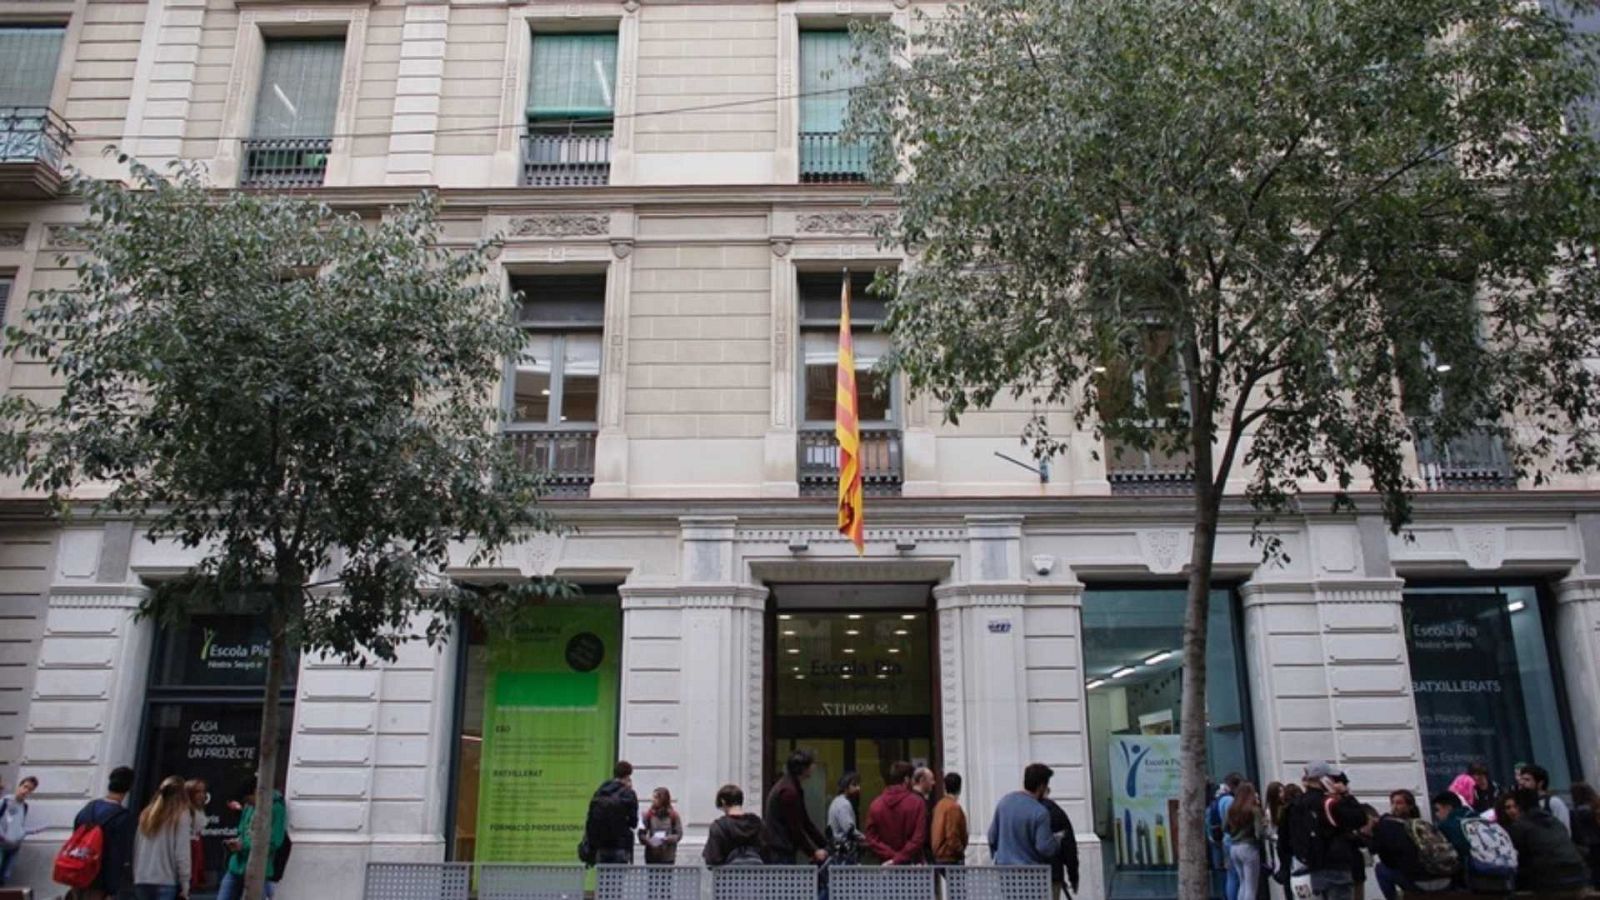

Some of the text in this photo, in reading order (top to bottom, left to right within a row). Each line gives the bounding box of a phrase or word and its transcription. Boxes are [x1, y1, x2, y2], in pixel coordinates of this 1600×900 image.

[1413, 622, 1478, 638] Escola Pia
[210, 644, 248, 657] Escola
[191, 720, 219, 732] CADA
[187, 747, 256, 759] UN PROJECTE
